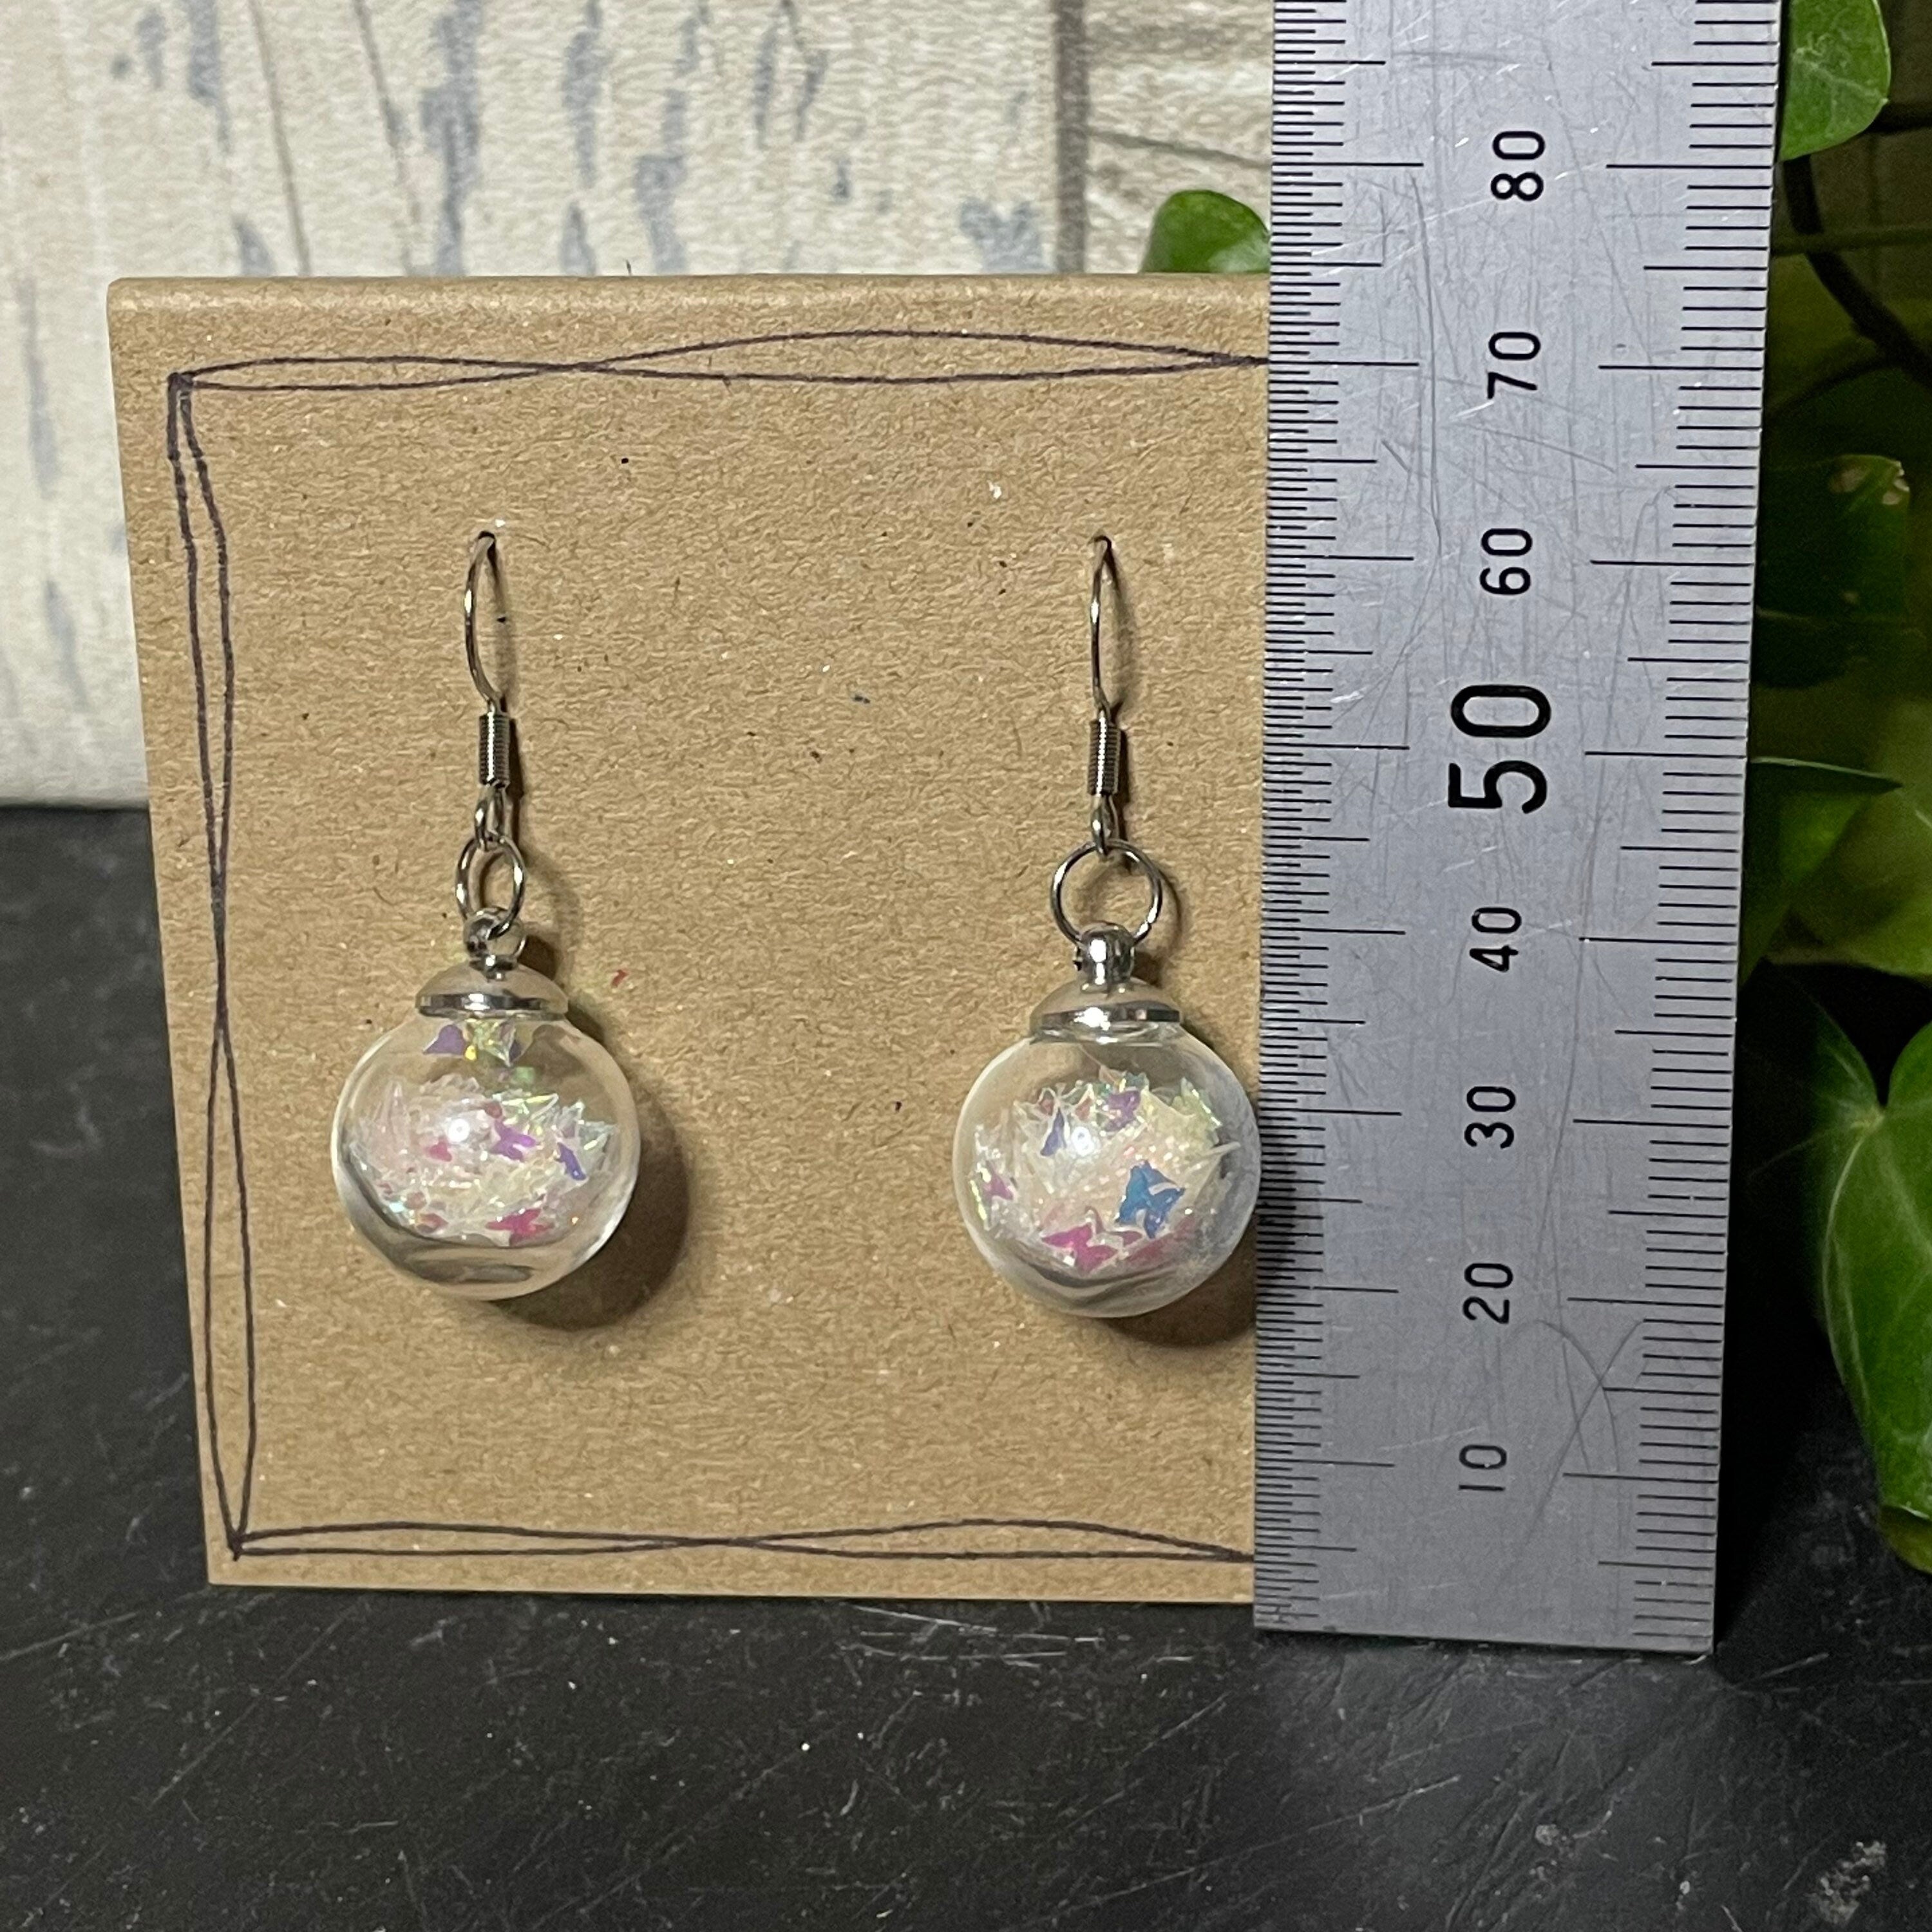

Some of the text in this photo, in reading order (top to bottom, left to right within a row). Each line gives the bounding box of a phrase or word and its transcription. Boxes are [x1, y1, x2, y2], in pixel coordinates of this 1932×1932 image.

[1492, 130, 1544, 202] 80
[1487, 331, 1540, 400] 70
[1480, 527, 1532, 596] 60
[1448, 685, 1551, 814] 50
[1470, 906, 1521, 973] 40
[1464, 1085, 1515, 1150] 30
[1463, 1262, 1513, 1325] 20
[1459, 1444, 1506, 1492] 10
